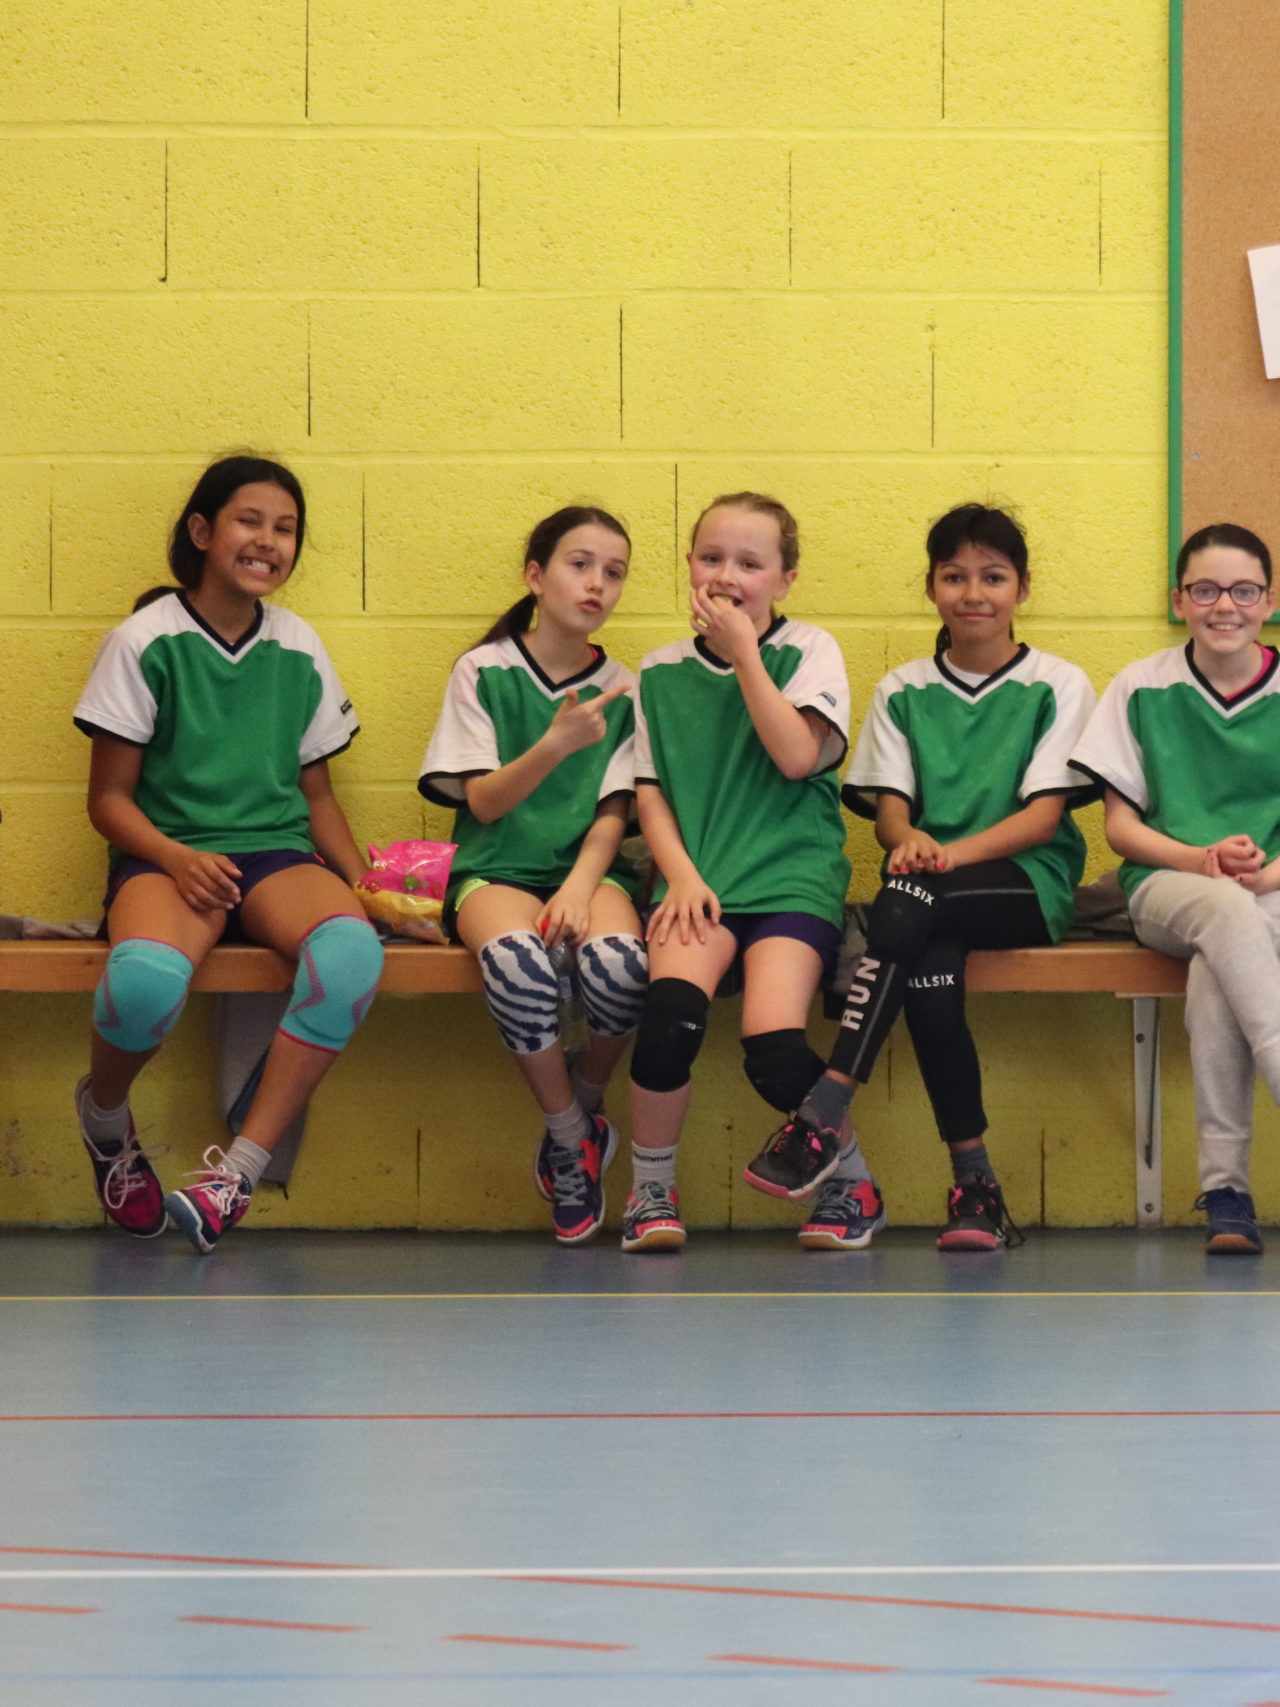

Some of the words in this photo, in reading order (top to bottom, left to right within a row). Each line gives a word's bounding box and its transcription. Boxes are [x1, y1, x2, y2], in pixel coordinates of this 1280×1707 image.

[887, 879, 935, 906] ALLSIX
[841, 956, 881, 1031] RUN
[908, 974, 955, 989] ALLSIX
